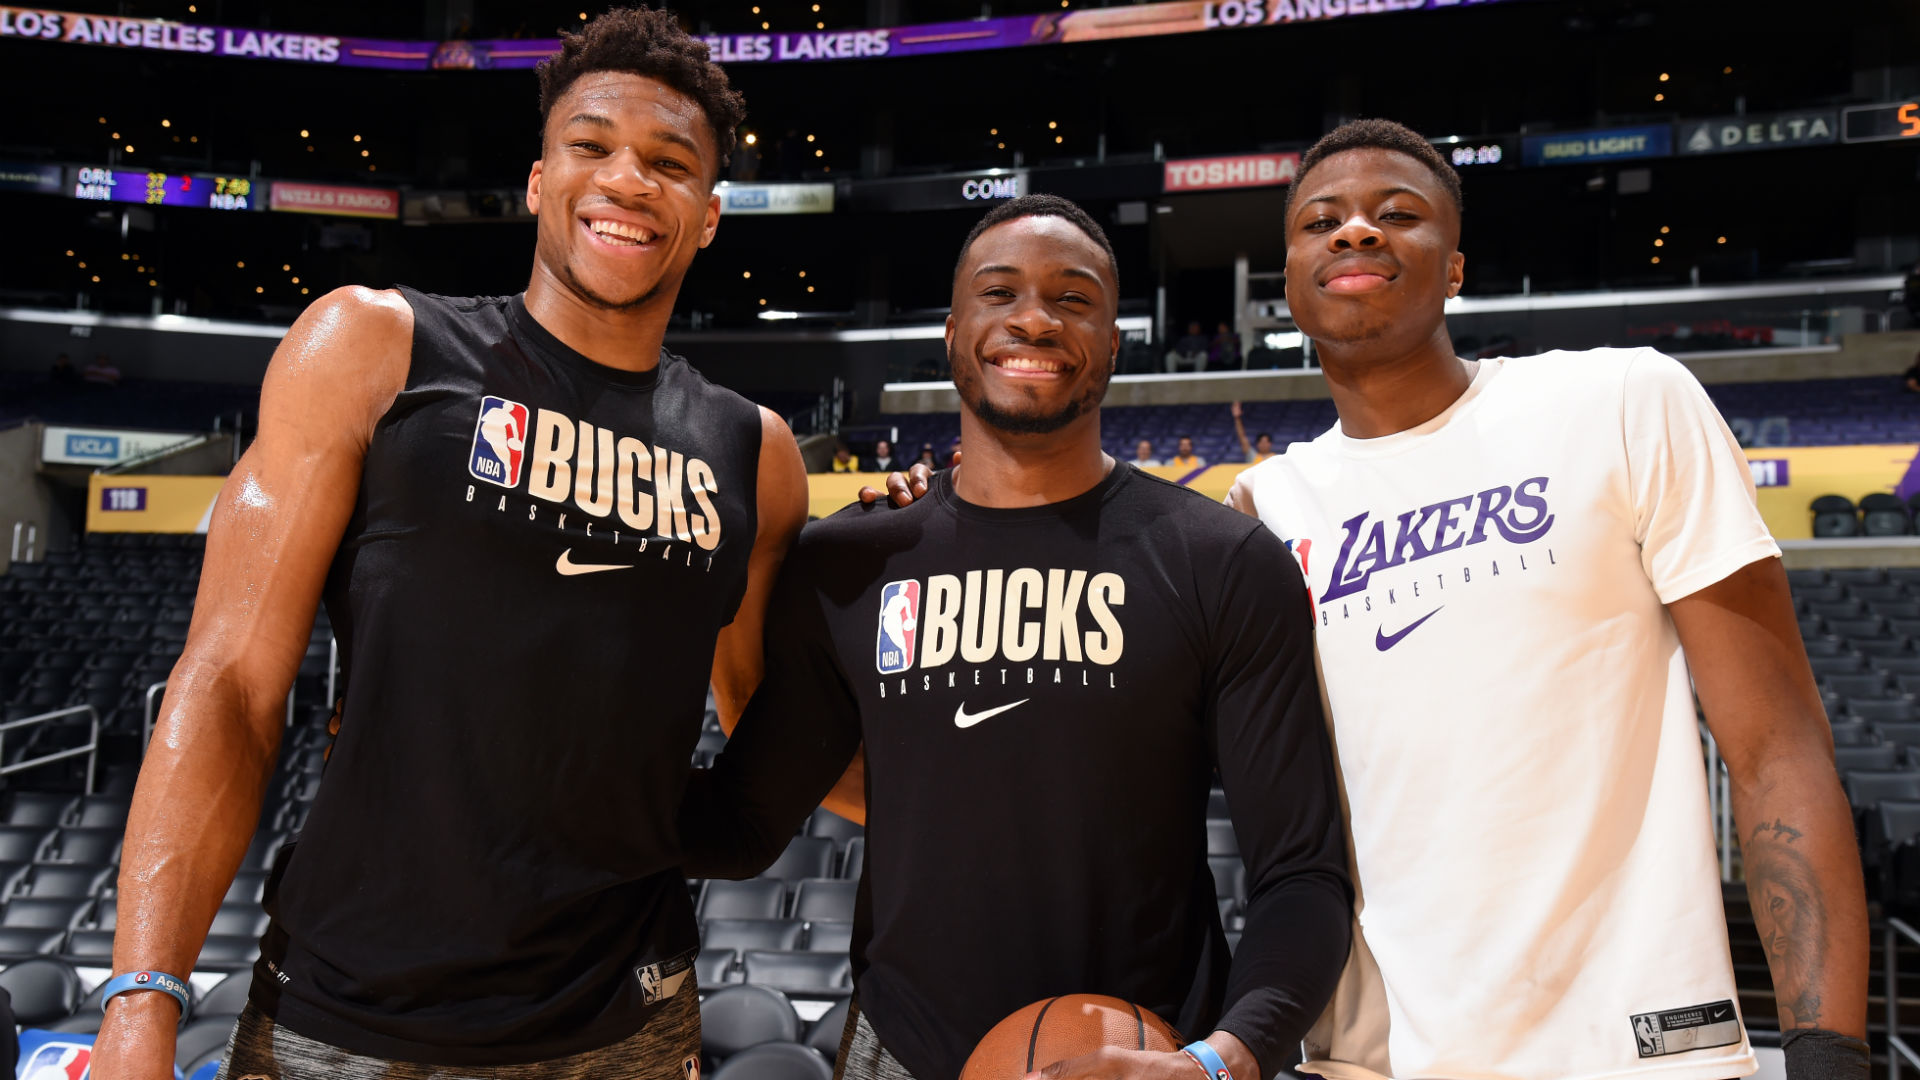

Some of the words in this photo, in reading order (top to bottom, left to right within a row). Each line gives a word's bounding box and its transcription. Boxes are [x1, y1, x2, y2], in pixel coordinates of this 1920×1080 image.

[1204, 0, 1264, 27] LOS
[0, 8, 60, 38] LOS
[68, 18, 215, 53] ANGELES
[223, 30, 341, 62] LAKERS
[702, 36, 771, 62] ELES
[779, 30, 890, 59] LAKERS
[1721, 118, 1829, 146] DELTA
[1897, 103, 1920, 137] 5
[1588, 136, 1647, 156] LIGHT
[78, 167, 117, 186] ORL
[180, 175, 192, 192] 2
[1169, 157, 1296, 187] TOSHIBA
[209, 193, 247, 210] NBA
[280, 189, 336, 206] WELLS
[337, 192, 391, 210] FARGO
[71, 438, 113, 455] UCLA
[476, 456, 500, 478] NBA
[528, 408, 721, 550] BUCKS
[110, 489, 138, 510] 118
[466, 484, 712, 572] BASKETBALL
[1319, 476, 1555, 604] LAKERS
[1322, 548, 1556, 626] BASKETBALL
[920, 567, 1126, 669] BUCKS
[882, 651, 900, 668] NBA
[879, 668, 1115, 698] BASKETBALL
